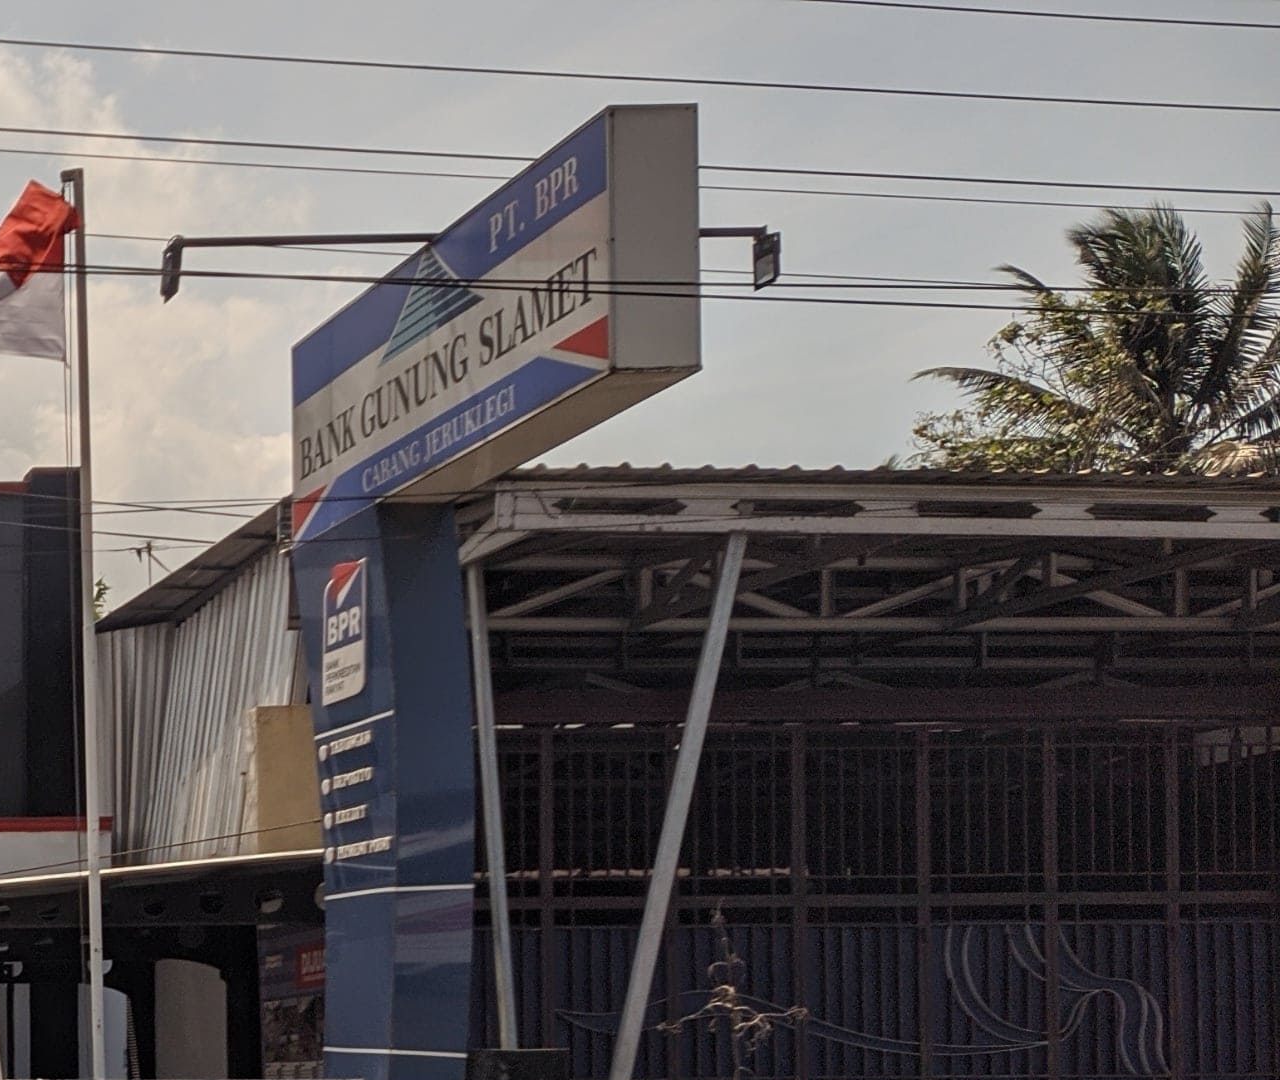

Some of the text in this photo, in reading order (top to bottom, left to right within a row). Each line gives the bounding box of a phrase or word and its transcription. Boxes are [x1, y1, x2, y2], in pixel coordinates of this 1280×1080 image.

[489, 156, 579, 254] PT. BPR
[300, 246, 598, 481] BANK GUNUNG SLAMET
[361, 384, 516, 493] CABANG JERUKLEGI
[327, 605, 362, 647] BPR
